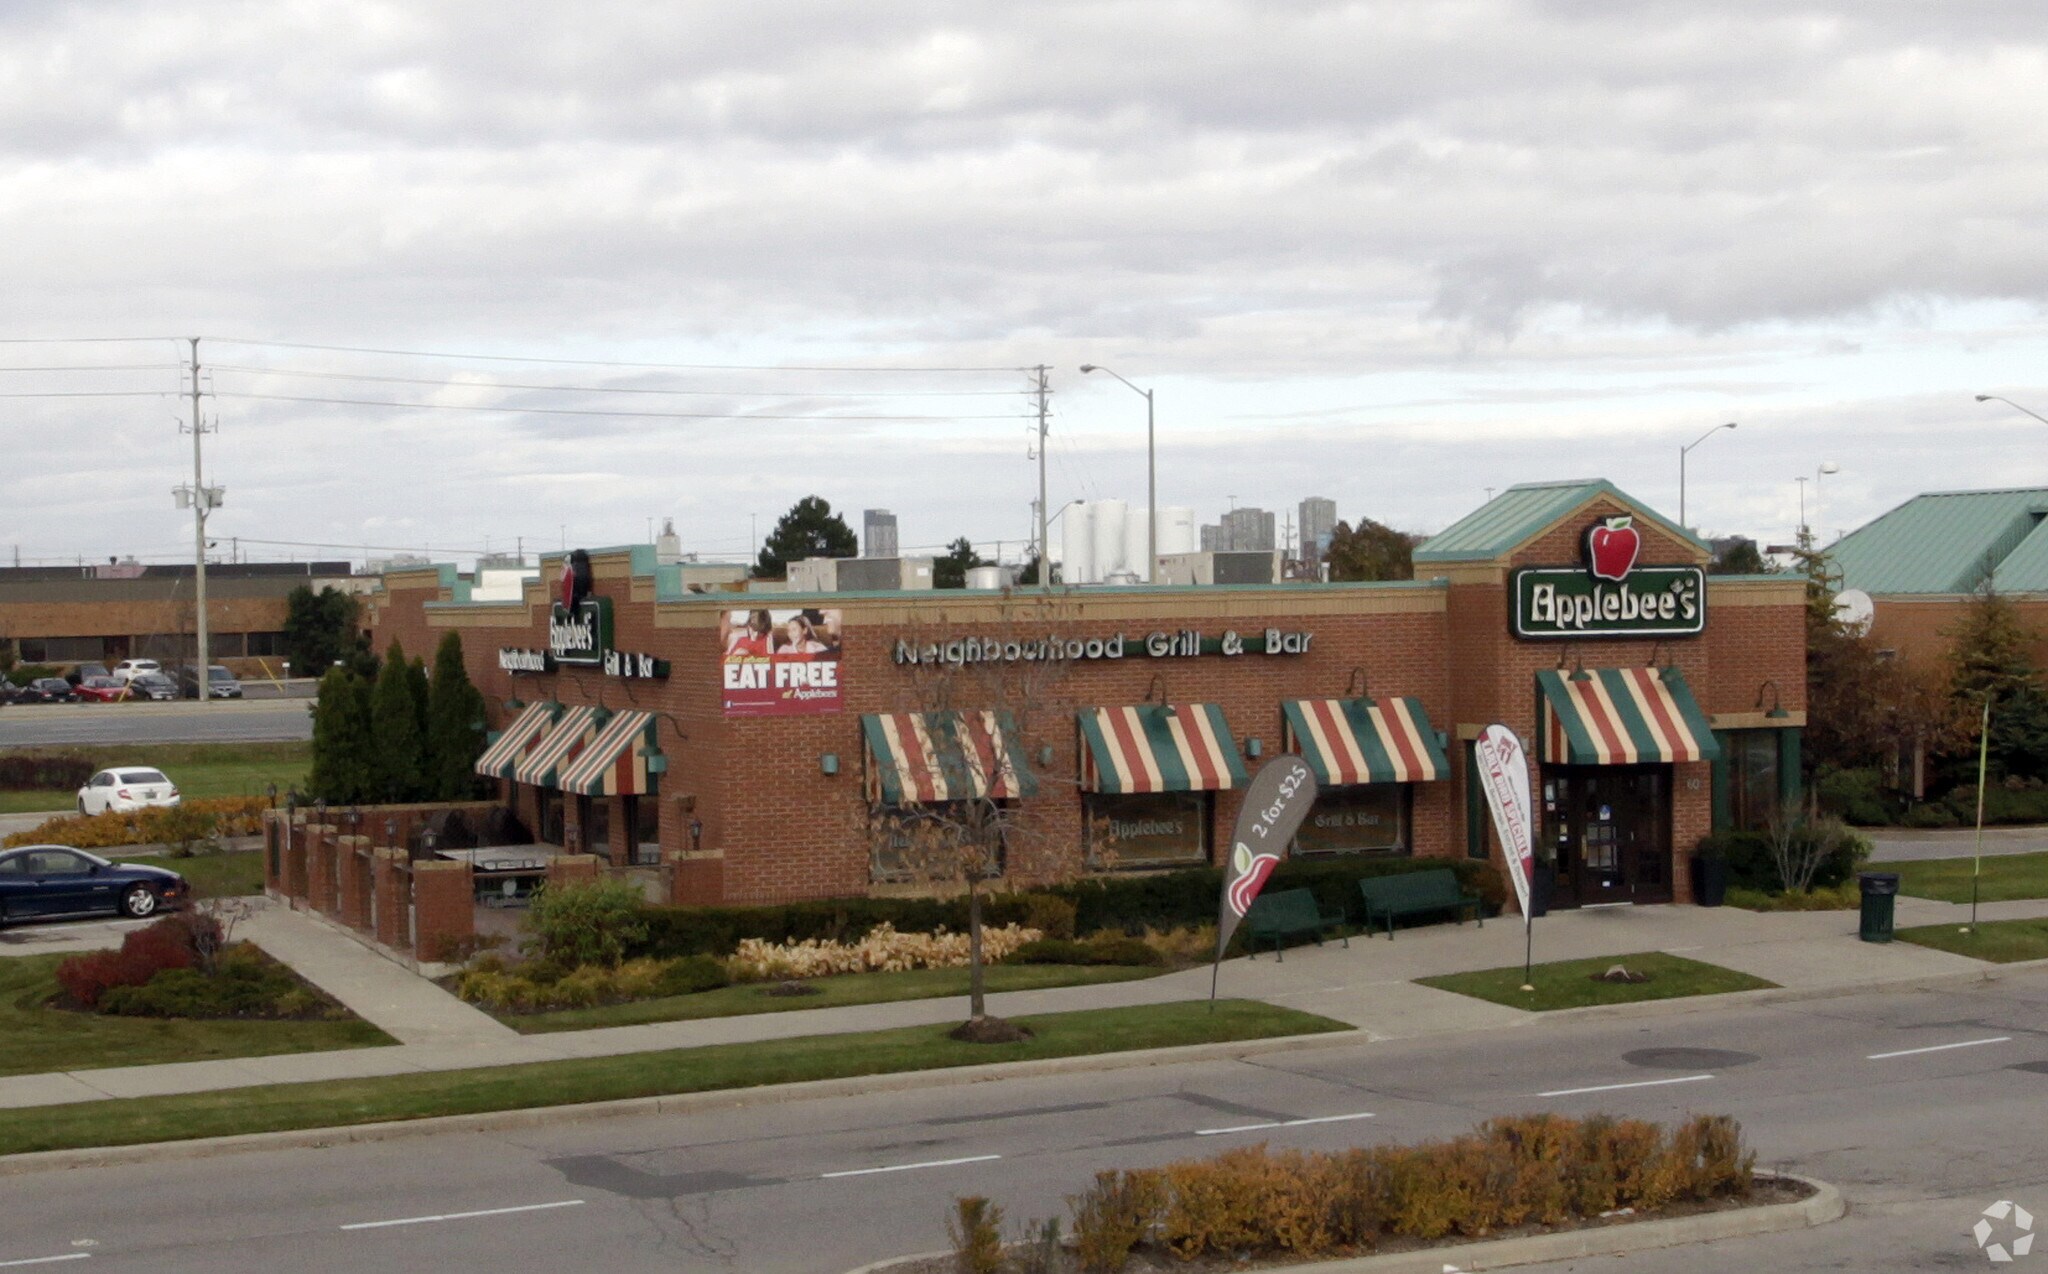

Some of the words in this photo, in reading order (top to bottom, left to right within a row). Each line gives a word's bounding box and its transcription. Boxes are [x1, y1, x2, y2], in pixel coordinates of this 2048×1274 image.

[1531, 578, 1695, 629] Applebee's
[896, 634, 1124, 668] Neighbourhood
[1145, 630, 1201, 657] Grill
[1222, 631, 1243, 656] &
[1265, 629, 1313, 654] Bar
[724, 663, 770, 689] EAT
[775, 661, 837, 688] FREE
[1252, 824, 1268, 838] 2
[1262, 798, 1285, 825] for
[1279, 765, 1306, 799] $25
